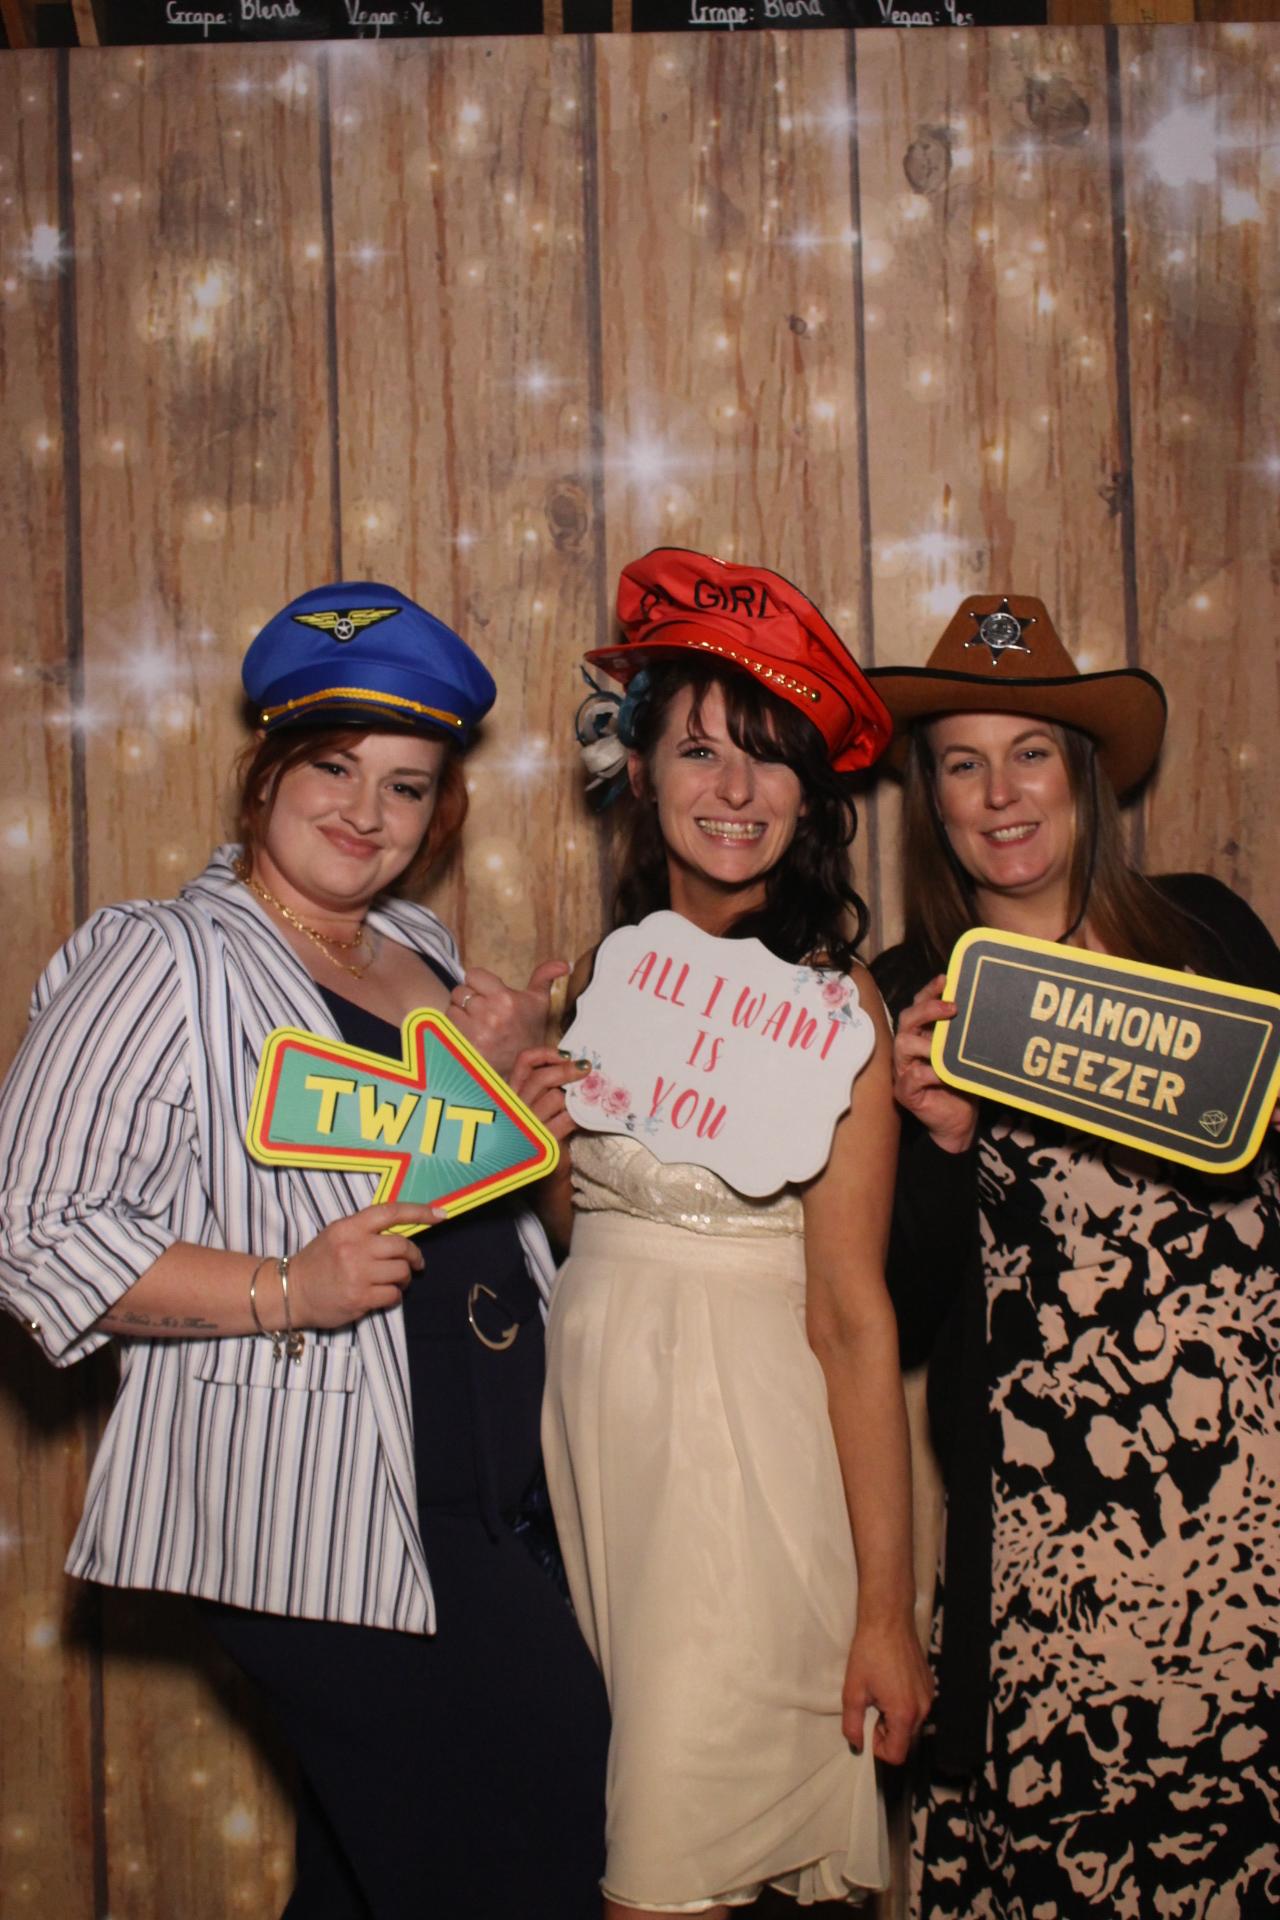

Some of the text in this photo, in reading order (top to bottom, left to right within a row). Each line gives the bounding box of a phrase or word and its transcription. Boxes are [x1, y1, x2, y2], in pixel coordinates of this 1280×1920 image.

[166, 0, 300, 38] Grape: Blend
[765, 0, 824, 17] Blend
[694, 579, 775, 619] GIRL
[628, 951, 847, 1060] ALL I WANT
[1030, 980, 1202, 1061] DIAMOND
[685, 1029, 724, 1072] IS
[1022, 1036, 1186, 1115] GEEZER
[304, 1074, 496, 1165] TWIT
[649, 1076, 727, 1140] YOU
